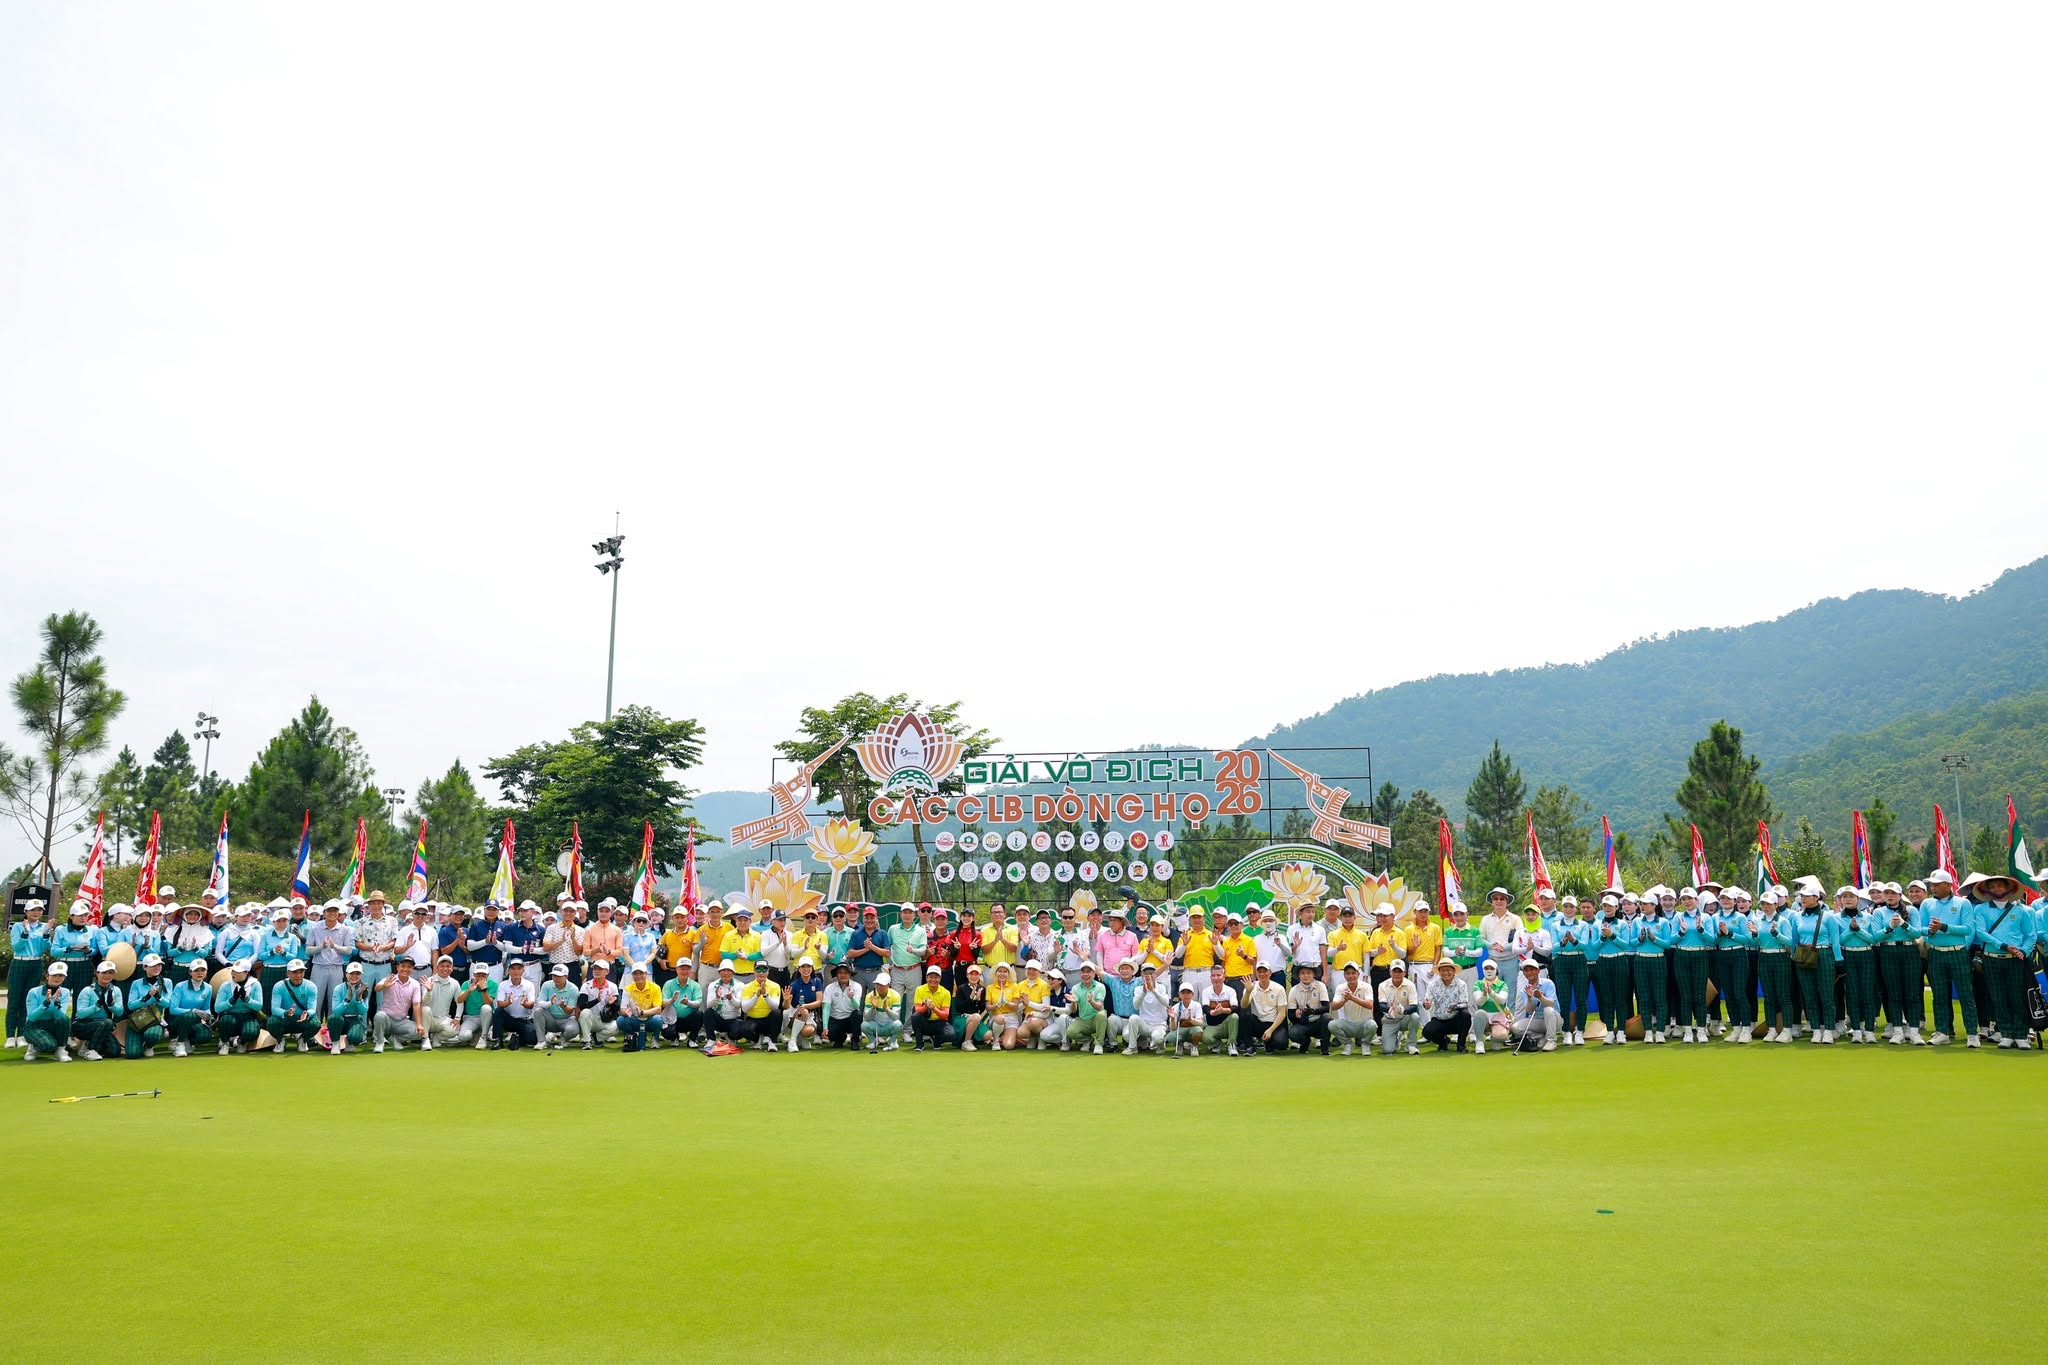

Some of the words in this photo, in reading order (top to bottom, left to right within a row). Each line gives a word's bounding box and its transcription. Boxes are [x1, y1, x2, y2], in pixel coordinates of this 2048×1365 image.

[963, 753, 1029, 784] GIẢI
[1043, 752, 1093, 783] VÔ
[1214, 750, 1260, 785] 20
[868, 788, 948, 824] CÁC
[956, 795, 1023, 824] CLB
[1032, 786, 1145, 823] DÒNG
[1152, 792, 1210, 829] HỌ
[1215, 781, 1262, 815] 26
